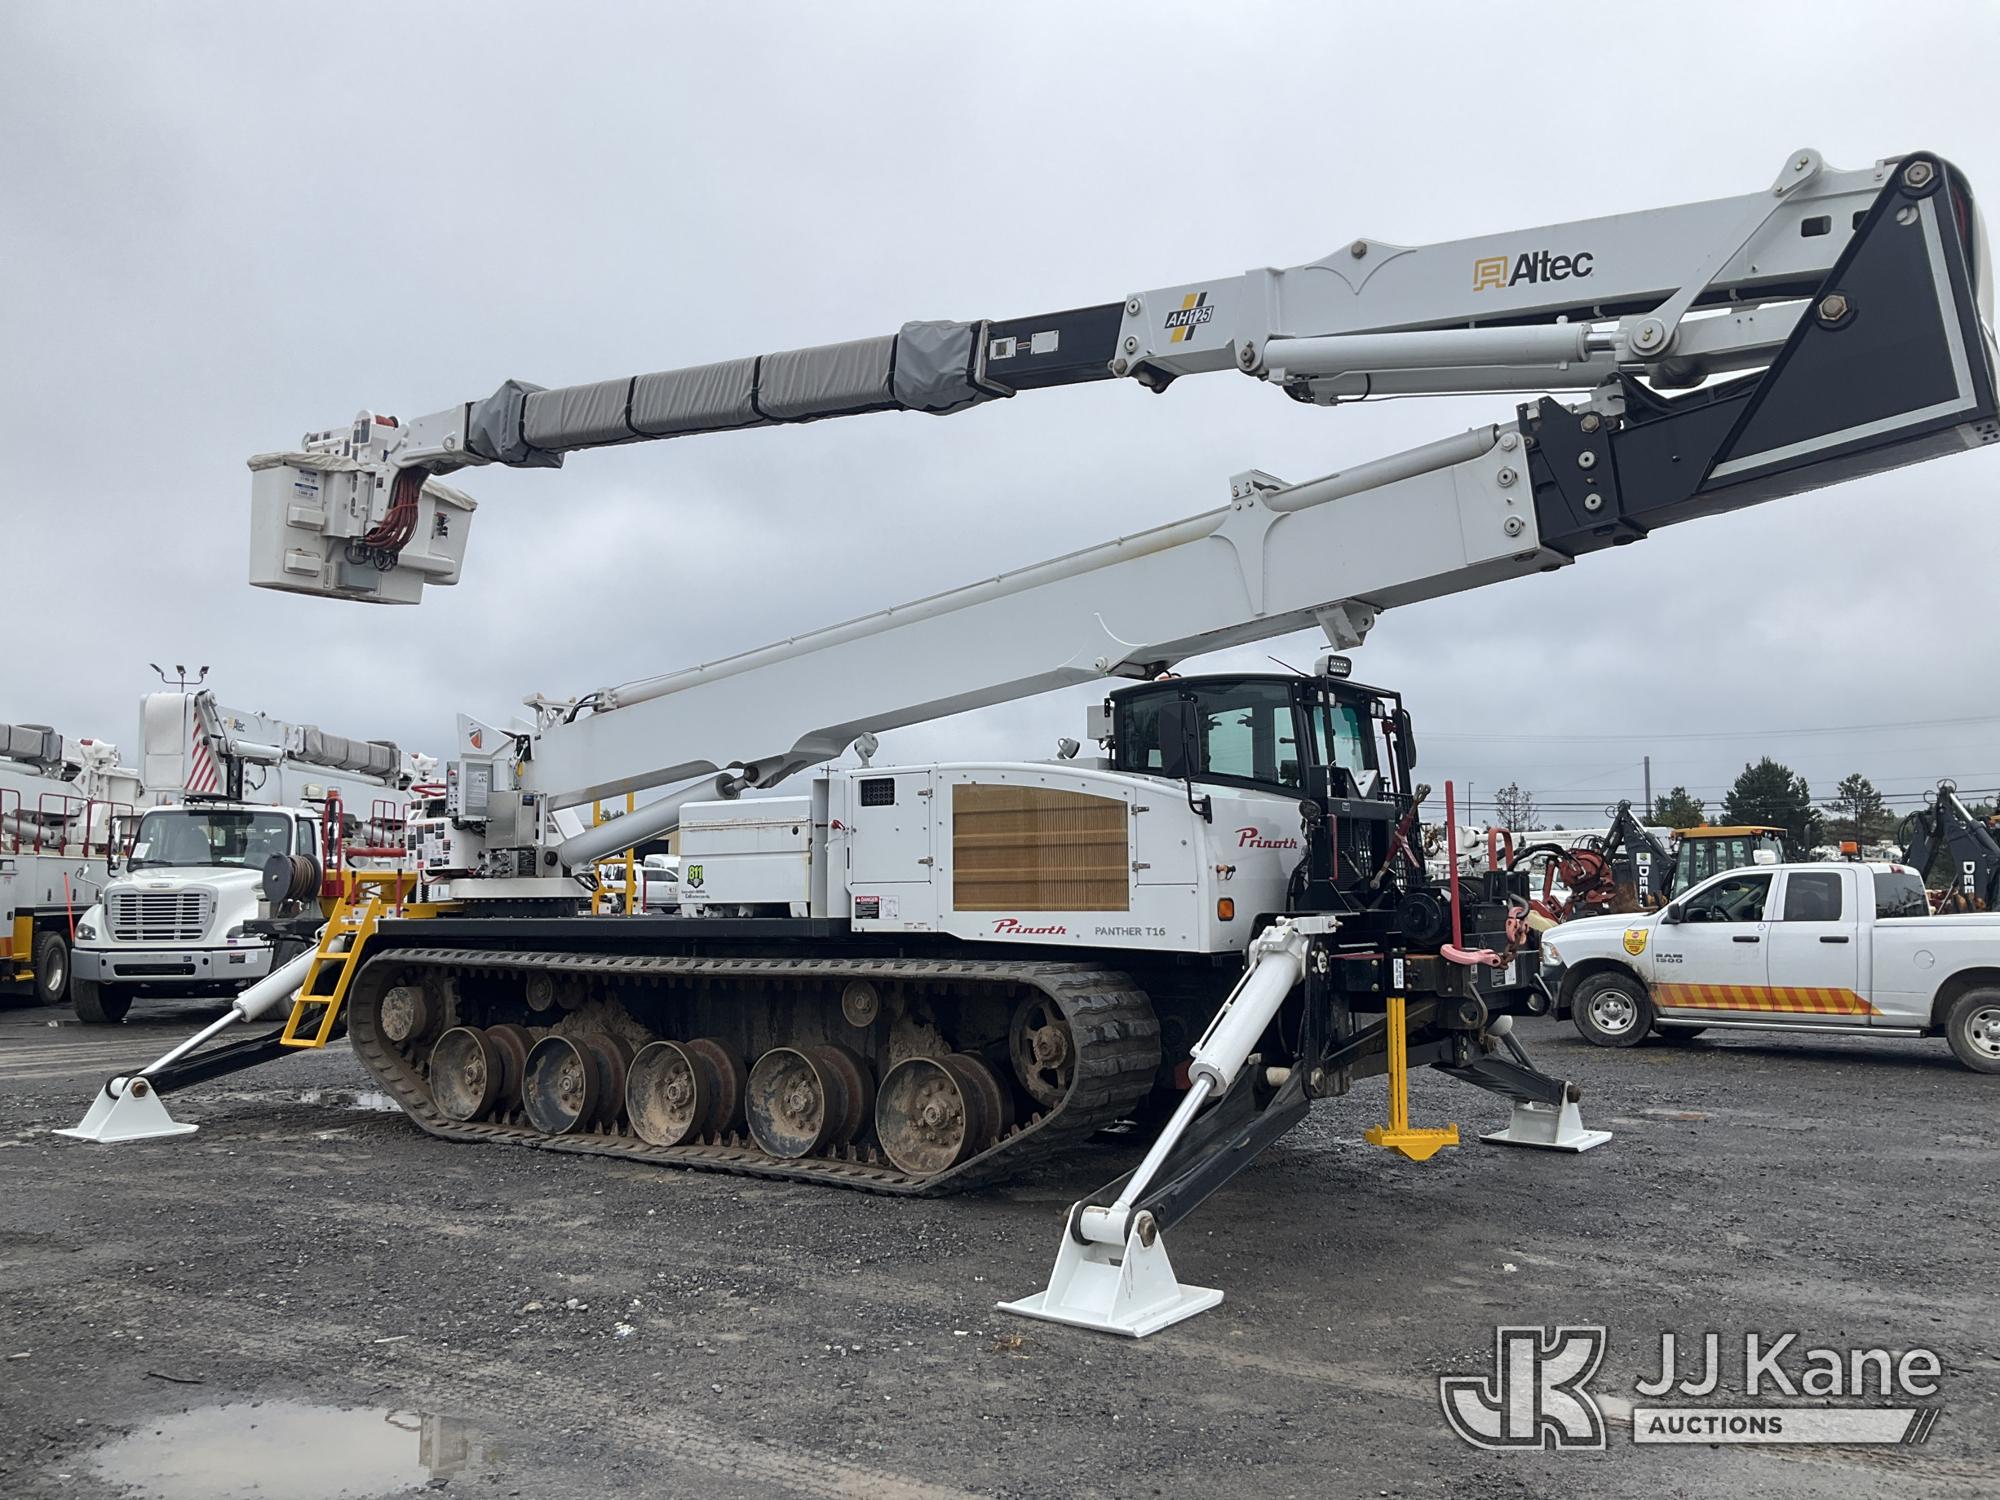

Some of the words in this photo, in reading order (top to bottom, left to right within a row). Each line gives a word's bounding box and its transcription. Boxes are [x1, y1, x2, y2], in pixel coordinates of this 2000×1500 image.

[1507, 249, 1594, 287] Altec
[1166, 306, 1213, 328] AH125
[1234, 826, 1298, 849] Prinoth
[688, 865, 703, 881] 811
[1638, 865, 1650, 899] DEE
[1963, 861, 1976, 894] DEE
[991, 918, 1067, 935] Prinoth
[1094, 926, 1142, 937] PANTHER
[1145, 927, 1166, 937] T16
